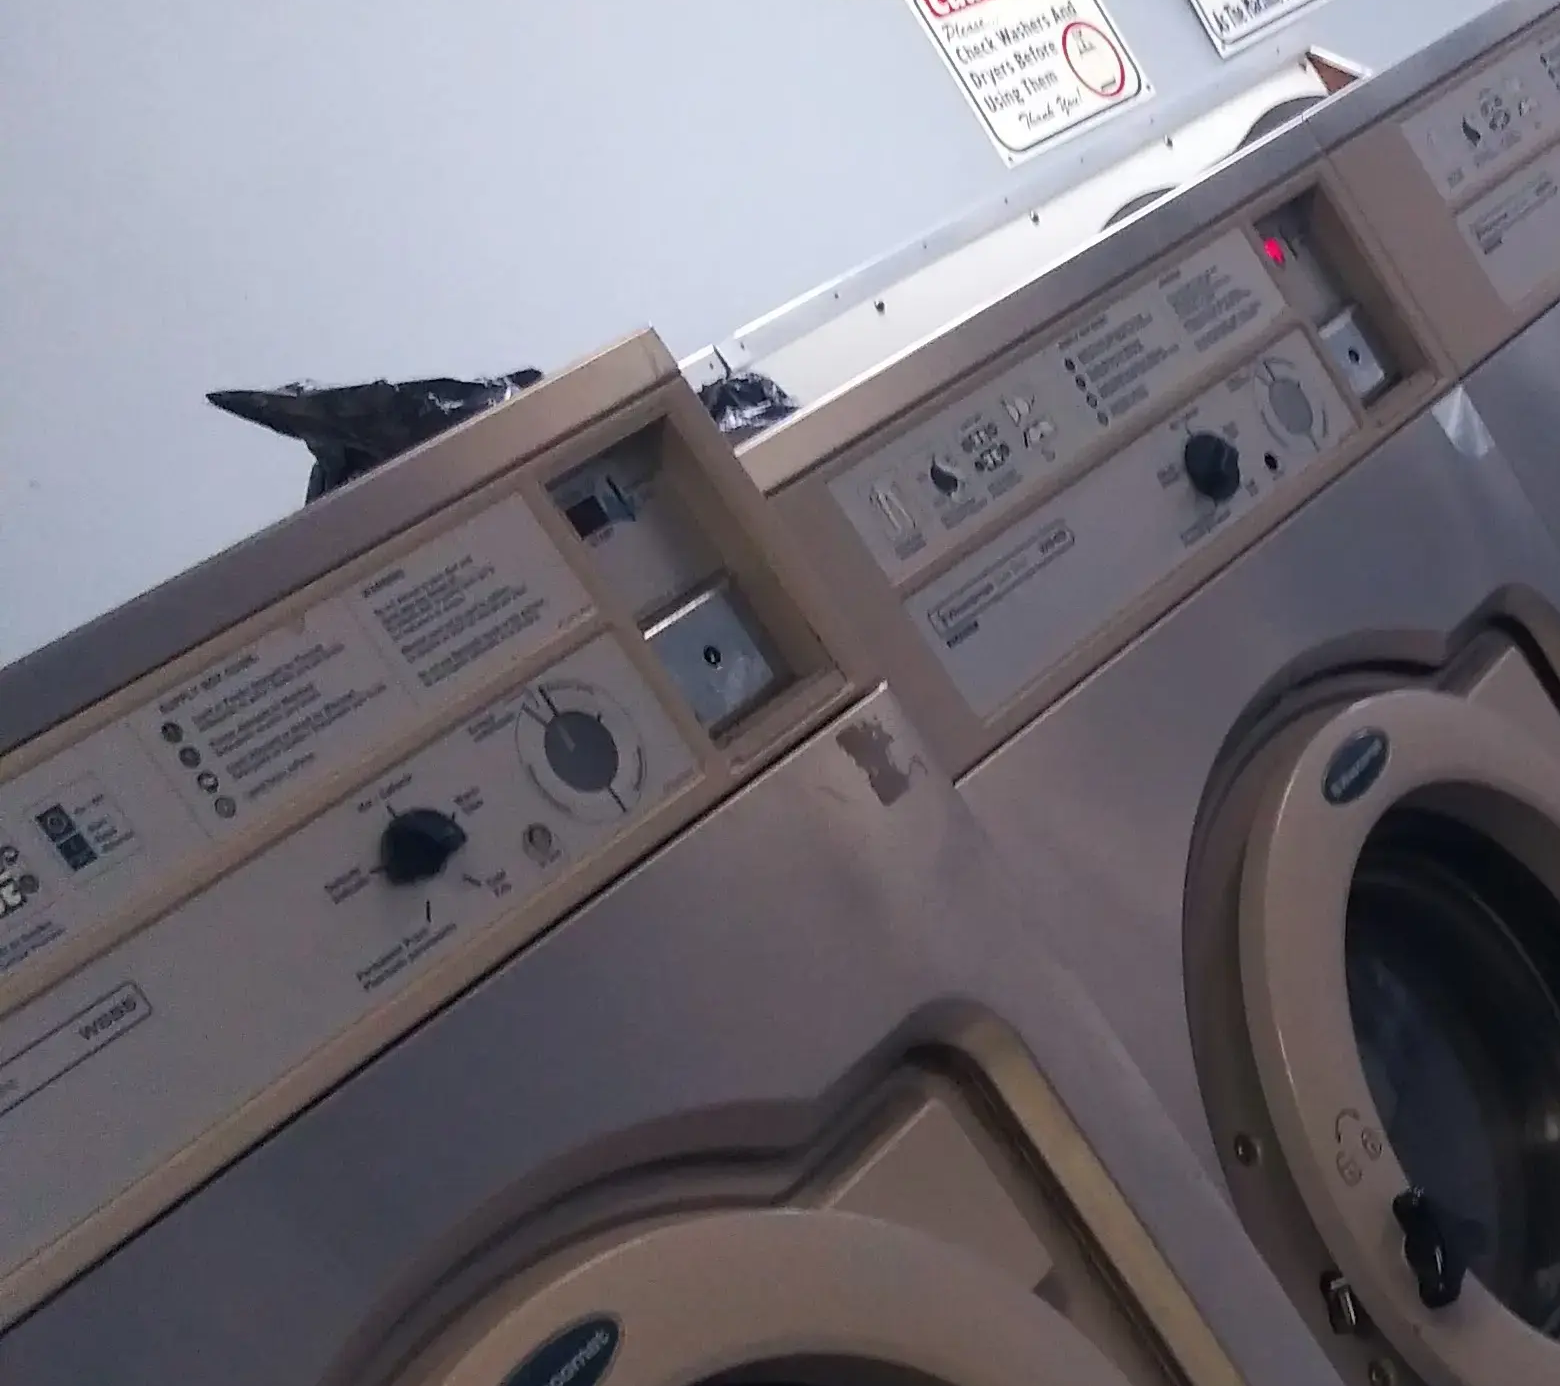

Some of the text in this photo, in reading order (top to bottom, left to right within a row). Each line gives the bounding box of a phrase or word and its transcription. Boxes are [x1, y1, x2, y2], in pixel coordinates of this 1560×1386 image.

[953, 33, 998, 65] Check
[994, 10, 1053, 48] Washers
[1210, 5, 1231, 36] As
[968, 36, 1059, 89] Dryers Before
[982, 66, 1060, 114] Using Them
[1016, 85, 1090, 132] Thank You!
